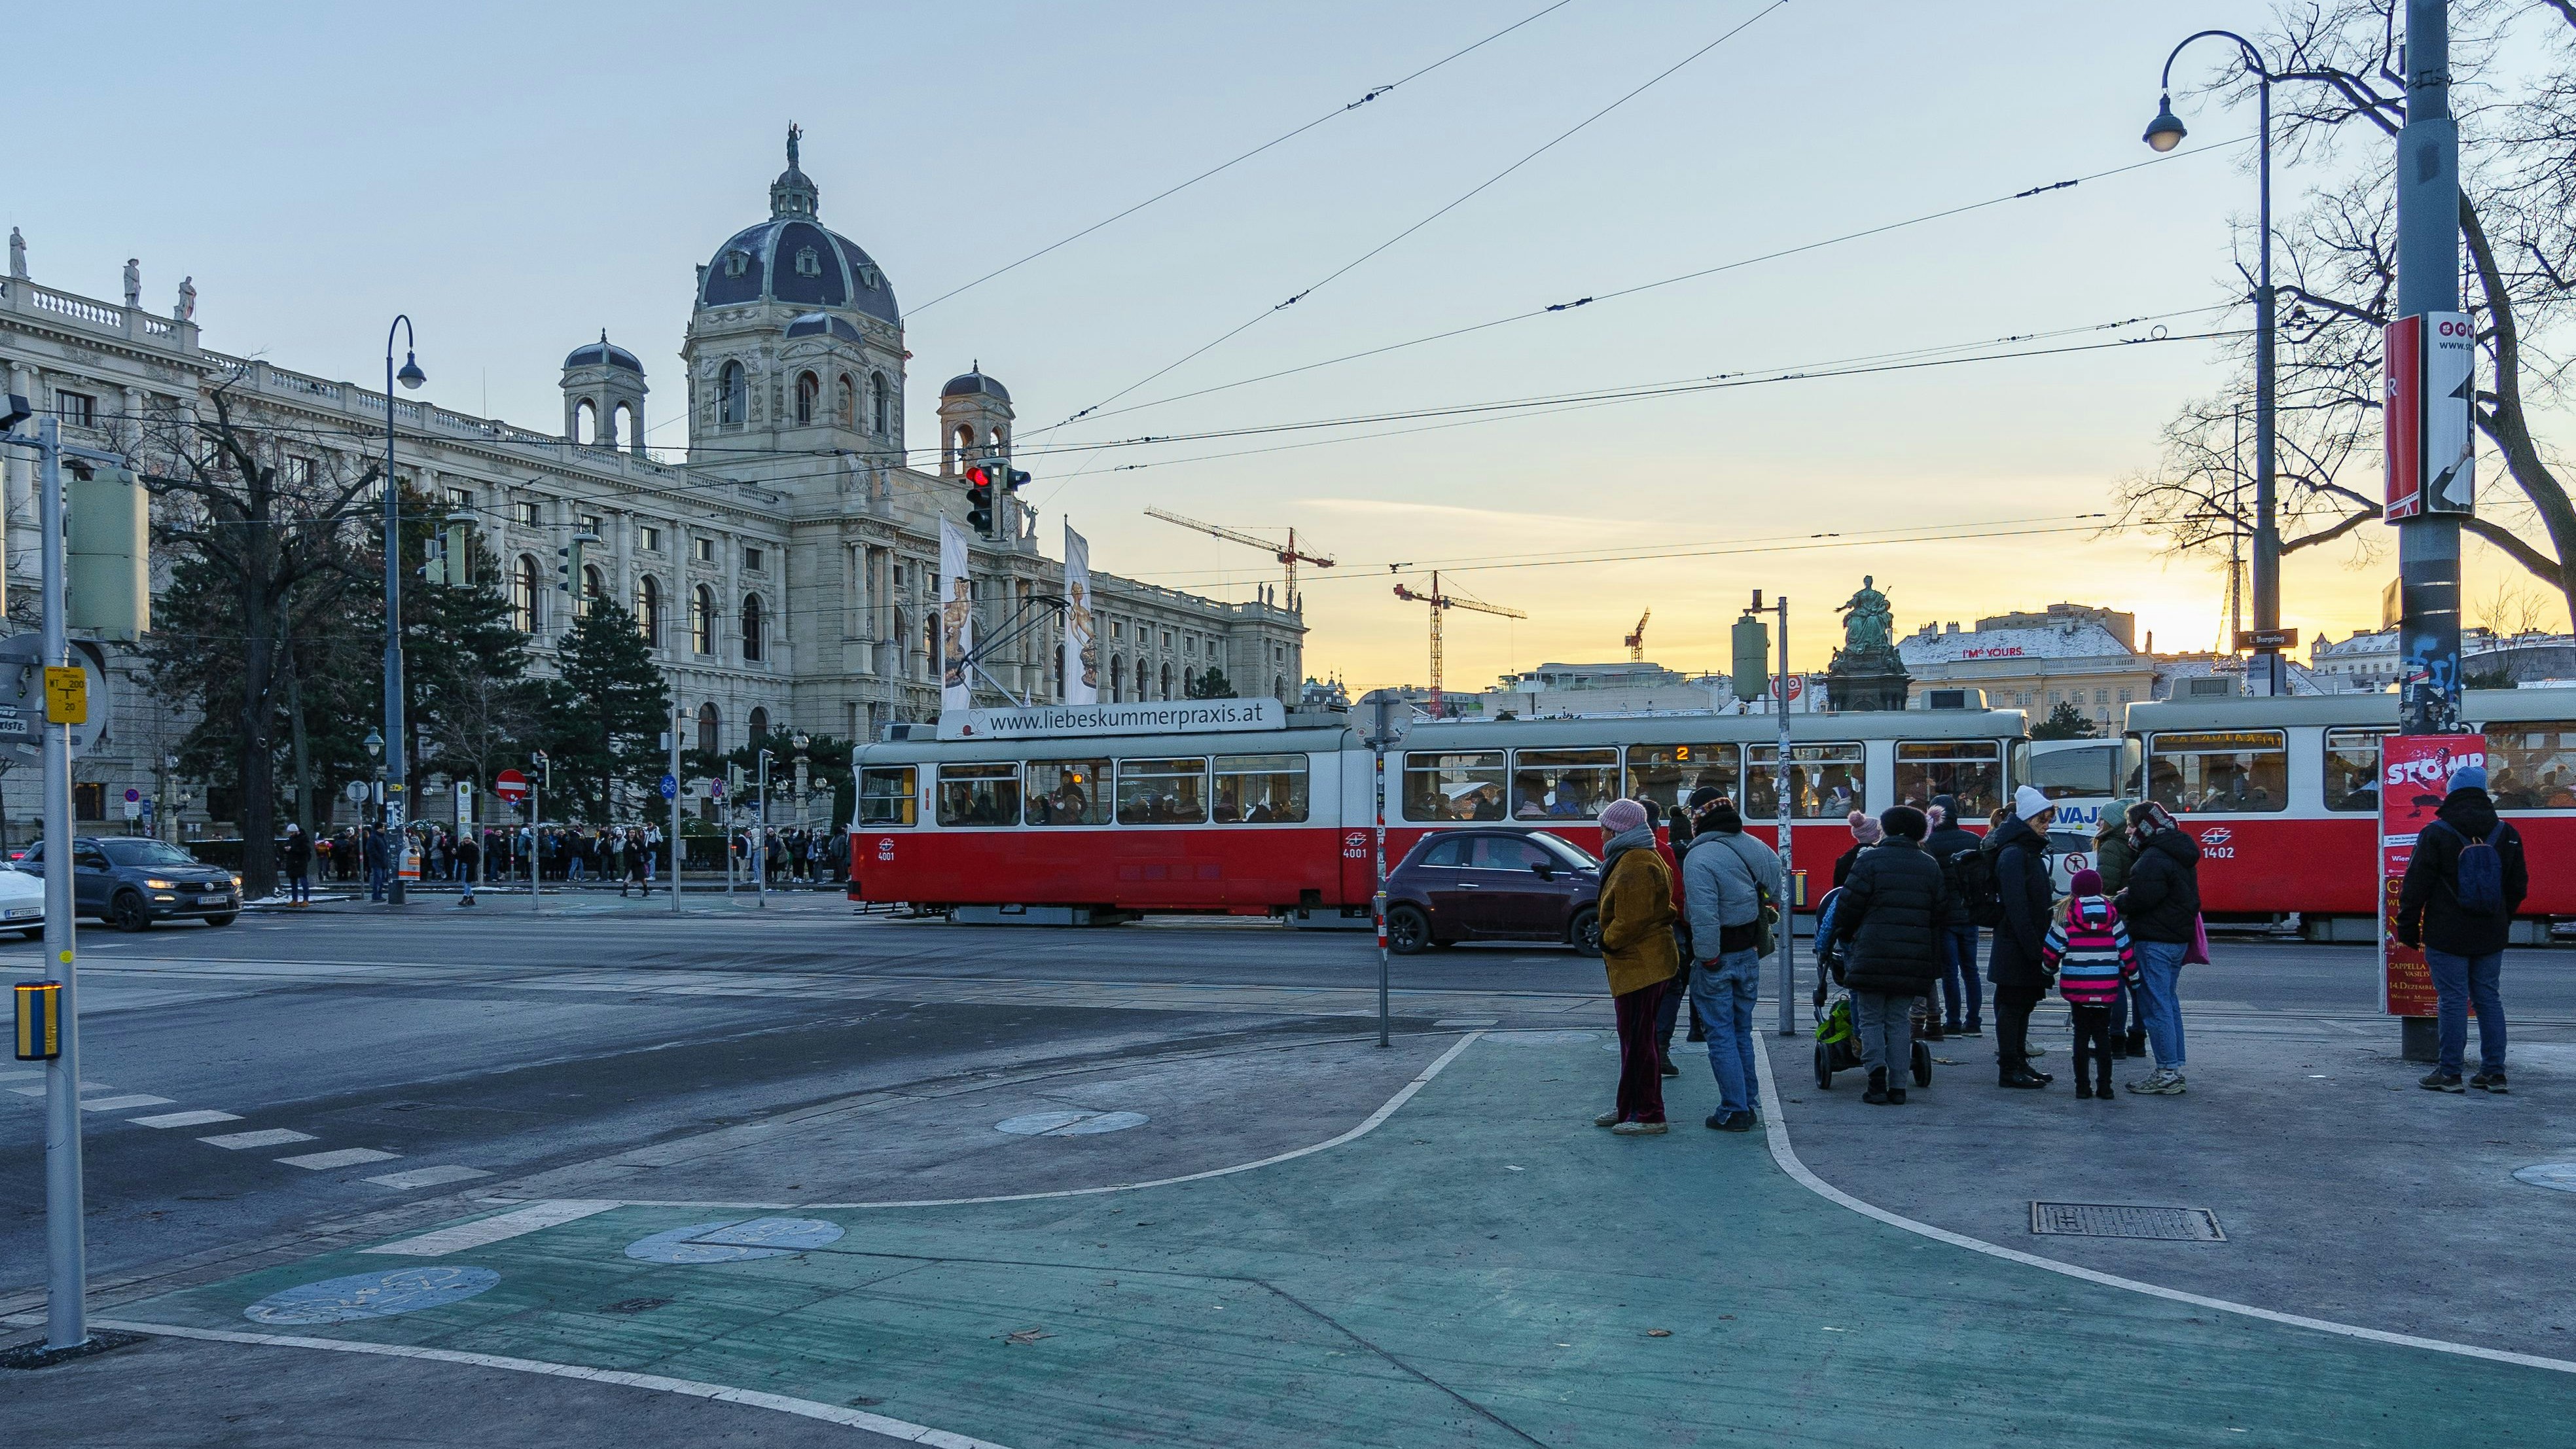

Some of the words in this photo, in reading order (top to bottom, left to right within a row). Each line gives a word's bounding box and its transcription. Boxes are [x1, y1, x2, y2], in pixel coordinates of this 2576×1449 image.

[2256, 635, 2285, 644] Burgring
[1986, 646, 2025, 657] YOURS.
[69, 680, 84, 689] 200
[65, 702, 75, 711] 20
[990, 702, 1263, 731] www.liebeskummerpraxis.at
[1676, 745, 1689, 760] 2
[2048, 806, 2102, 824] VAJ
[878, 852, 894, 861] 4001
[1343, 848, 1367, 858] 4001
[2202, 847, 2234, 859] 1402
